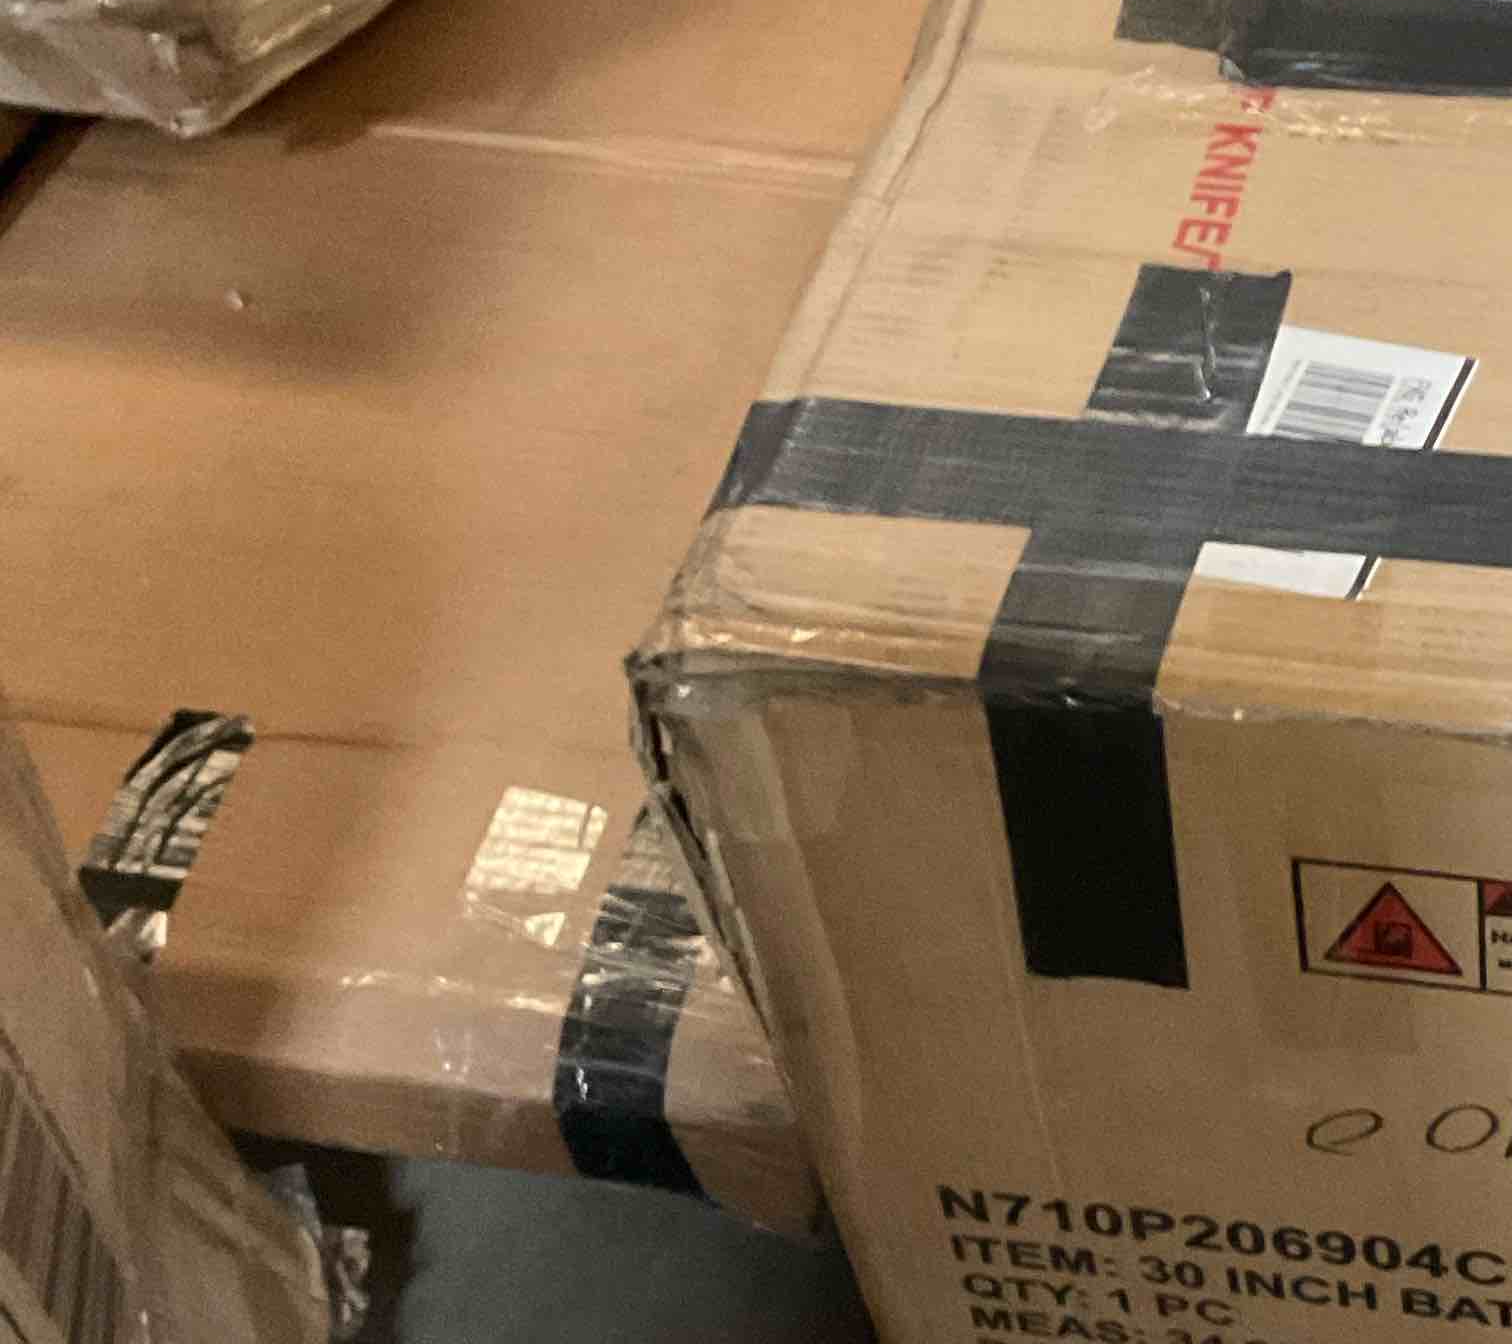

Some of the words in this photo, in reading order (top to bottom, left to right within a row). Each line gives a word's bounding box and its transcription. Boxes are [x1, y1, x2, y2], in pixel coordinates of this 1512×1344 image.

[937, 1184, 1507, 1286] N710P206904C
[950, 1234, 1118, 1278] ITEM:
[1138, 1254, 1205, 1290] 30
[1225, 1265, 1379, 1311] INCH
[962, 1272, 1091, 1310] QTY:
[1107, 1288, 1131, 1314] 1
[1155, 1292, 1236, 1327] PC
